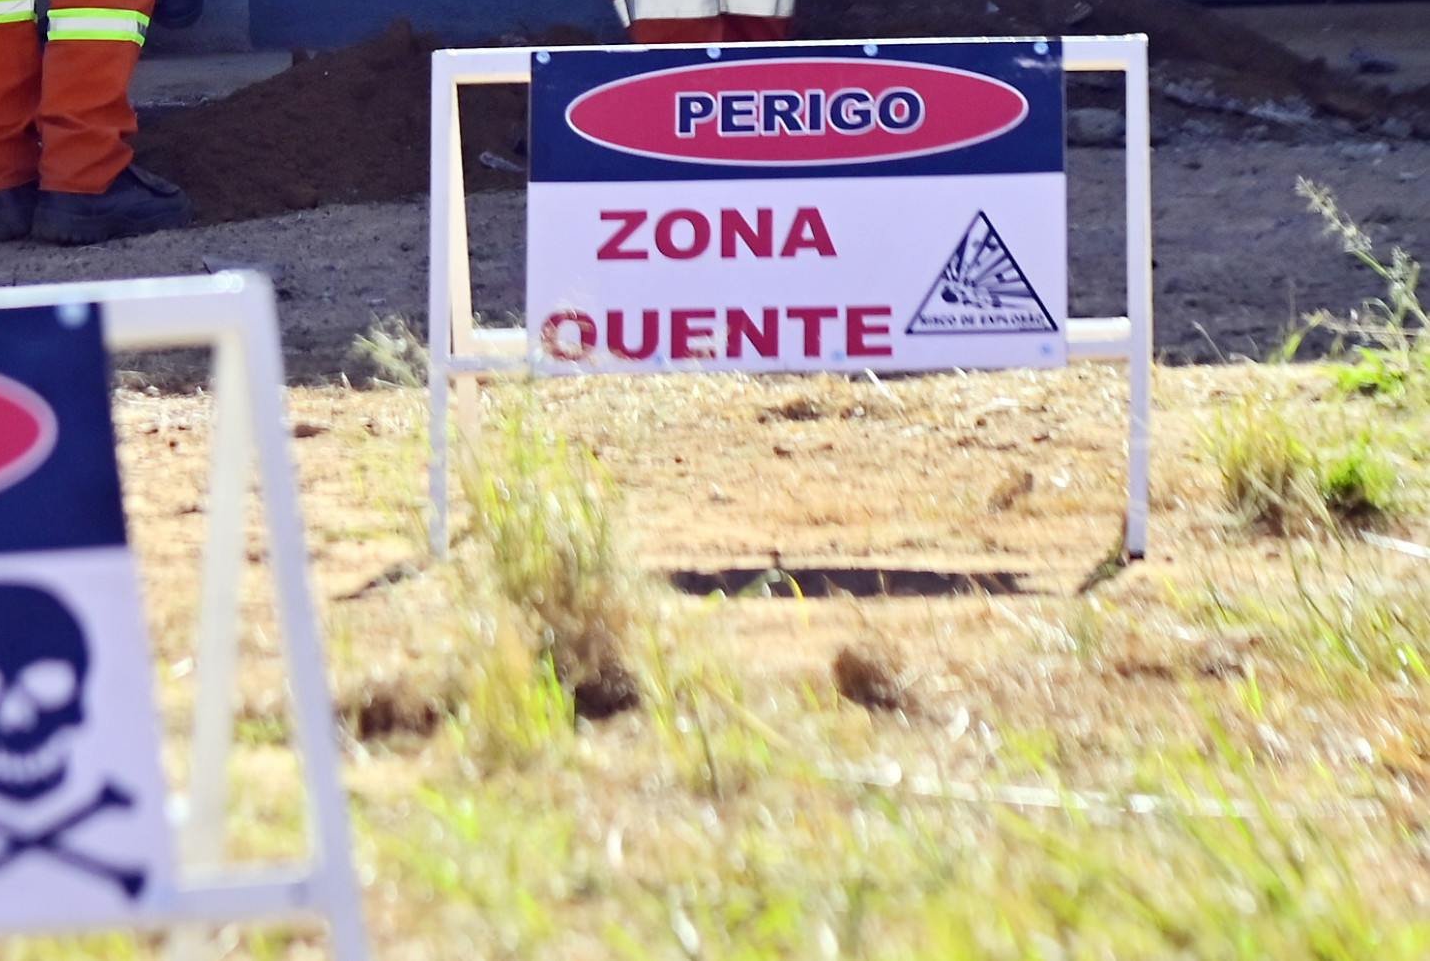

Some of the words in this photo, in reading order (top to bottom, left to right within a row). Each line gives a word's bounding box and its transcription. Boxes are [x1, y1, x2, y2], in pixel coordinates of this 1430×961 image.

[674, 86, 926, 138] PERIGO
[597, 206, 838, 261] ZONA
[541, 305, 893, 361] QUENTE
